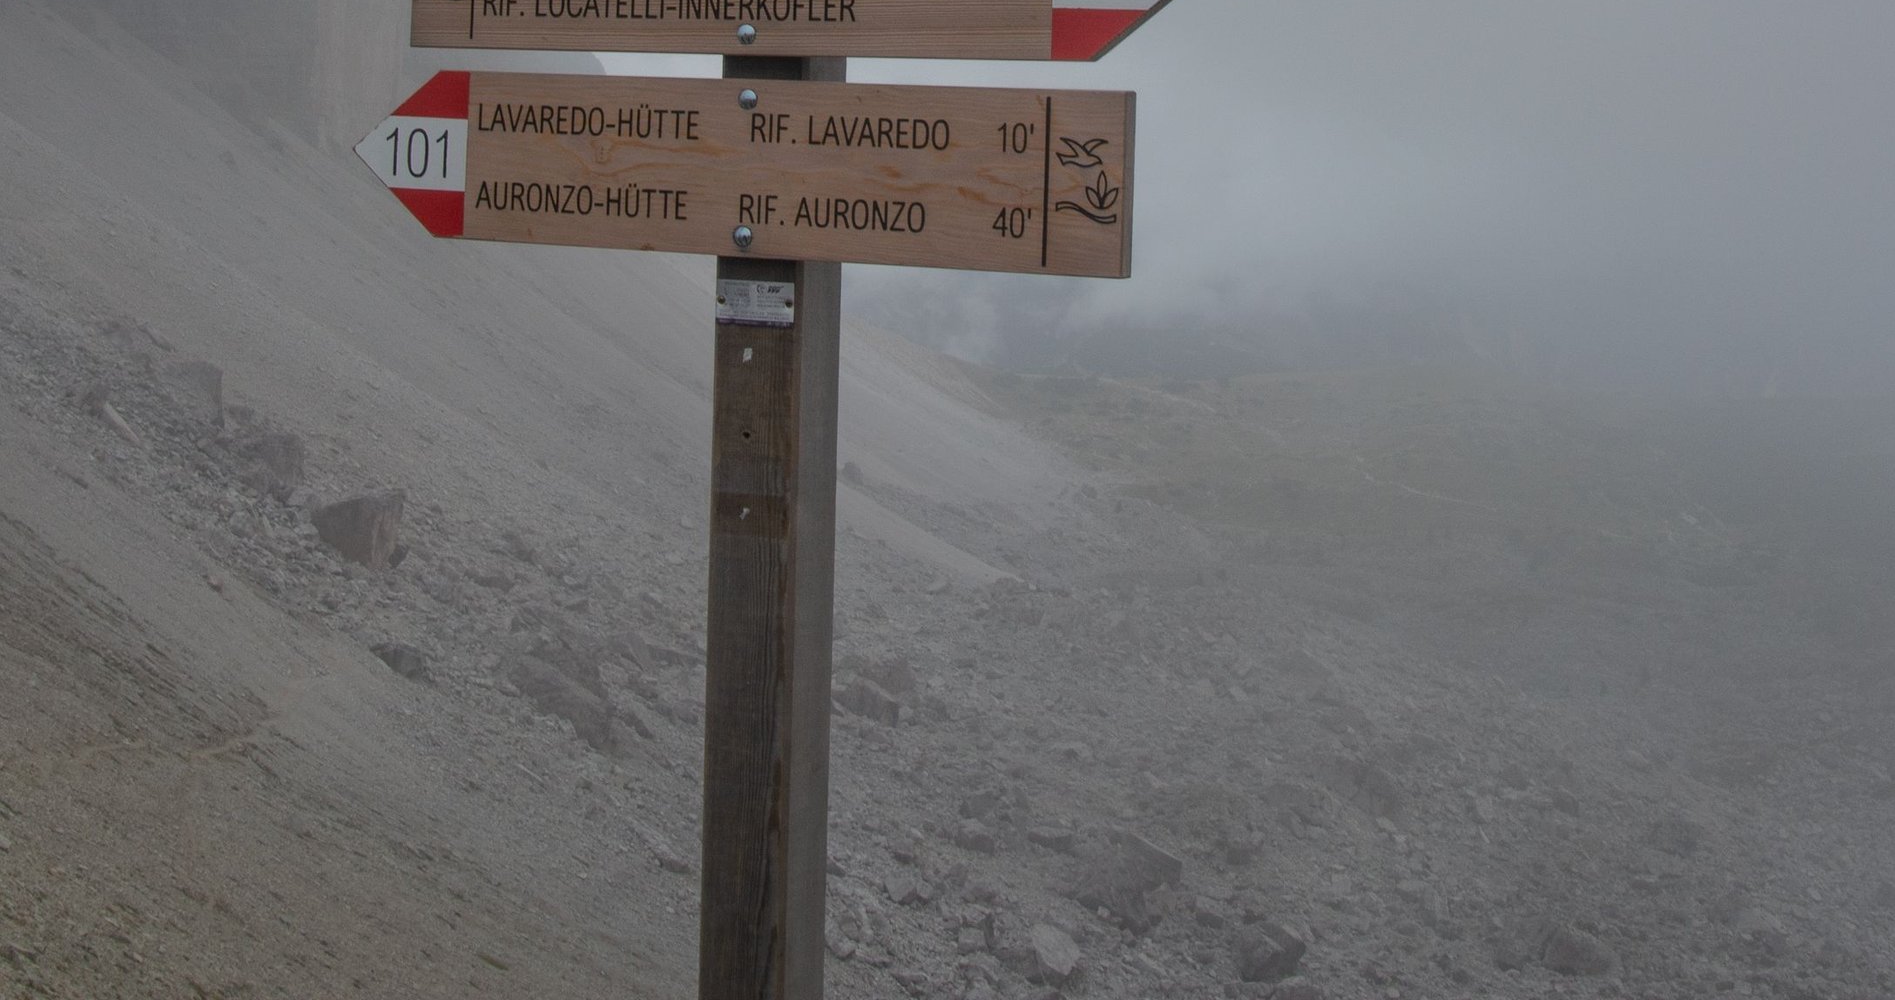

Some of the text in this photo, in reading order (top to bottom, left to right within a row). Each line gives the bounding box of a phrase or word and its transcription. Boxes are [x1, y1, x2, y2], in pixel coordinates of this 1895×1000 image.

[477, 102, 700, 141] LAVAREDO-HÜTTE
[750, 112, 950, 151] RIF. LAVAREDO
[997, 122, 1035, 154] 10'
[386, 127, 449, 179] 101
[475, 180, 688, 221] AURONZO-HÜTTE
[739, 193, 926, 234] RIF. AURONZO
[992, 206, 1032, 239] 40'
